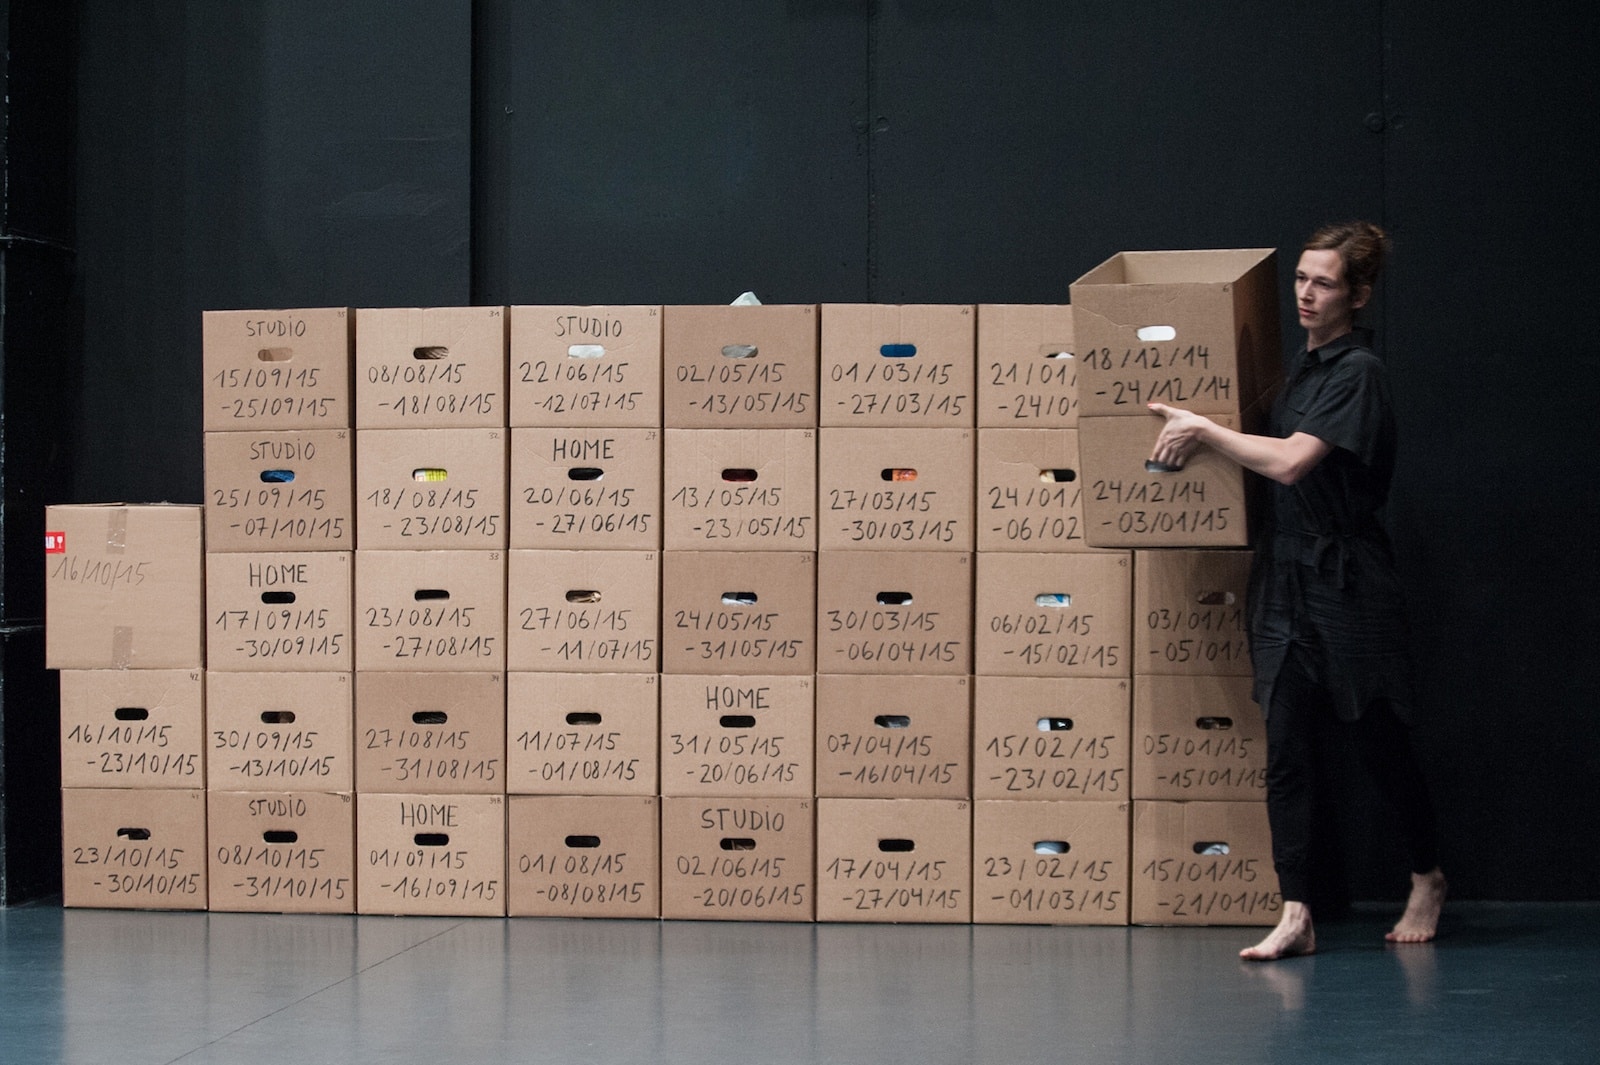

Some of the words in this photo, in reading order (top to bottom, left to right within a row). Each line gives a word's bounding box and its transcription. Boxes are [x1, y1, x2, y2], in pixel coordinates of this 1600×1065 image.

[1083, 345, 1209, 370] 18/12/14
[214, 368, 320, 388] 15/09/15
[369, 363, 466, 384] 08/08/15
[519, 361, 629, 383] 22/06/15
[677, 363, 785, 384] 02/05/15
[831, 362, 953, 385] 01/03/15
[646, 432, 656, 440] 27
[553, 438, 615, 462] HOME
[214, 488, 325, 510] 25/09/15
[367, 488, 478, 510] 18/08/15
[524, 487, 635, 507] 20/06/15
[672, 487, 781, 508] 13/05/15
[830, 489, 936, 512] 27/03/15
[1093, 480, 1204, 503] 24/12/14
[52, 556, 151, 589] 16/10/15
[249, 563, 308, 587] HOME
[216, 609, 328, 631] 17/09/15
[366, 607, 475, 627] 23/08/15
[520, 607, 631, 631] 27/06/15
[675, 610, 778, 631] 24/05/15
[827, 610, 939, 631] 30/03/15
[991, 614, 1093, 636] 06/02/15
[1148, 609, 1248, 631] 03/01/1
[1150, 640, 1248, 662] -05/01/
[190, 673, 200, 681] 42
[706, 686, 770, 710] HOME
[68, 724, 172, 747] 16/10/15
[214, 730, 318, 752] 30/09/15
[366, 729, 469, 750] 27/08/15
[517, 731, 621, 751] 11/07/15
[671, 734, 784, 758] 31/05/15
[828, 734, 932, 758] 07/04/15
[1146, 734, 1251, 758] 05/01/15
[986, 735, 1115, 759] 15/02/15
[1157, 768, 1268, 788] -15/01/15
[401, 802, 458, 827] HOME
[73, 846, 184, 869] 23/10/15
[218, 845, 325, 869] 08/10/15
[370, 849, 468, 869] 01/09/15
[519, 853, 626, 876] 01/08/15
[677, 856, 785, 878] 02/06/15
[826, 857, 946, 880] 17/04/15
[985, 857, 1112, 881] 23/02/15
[1143, 859, 1258, 882] 15/01/15
[1158, 892, 1281, 916] -21/01/15
